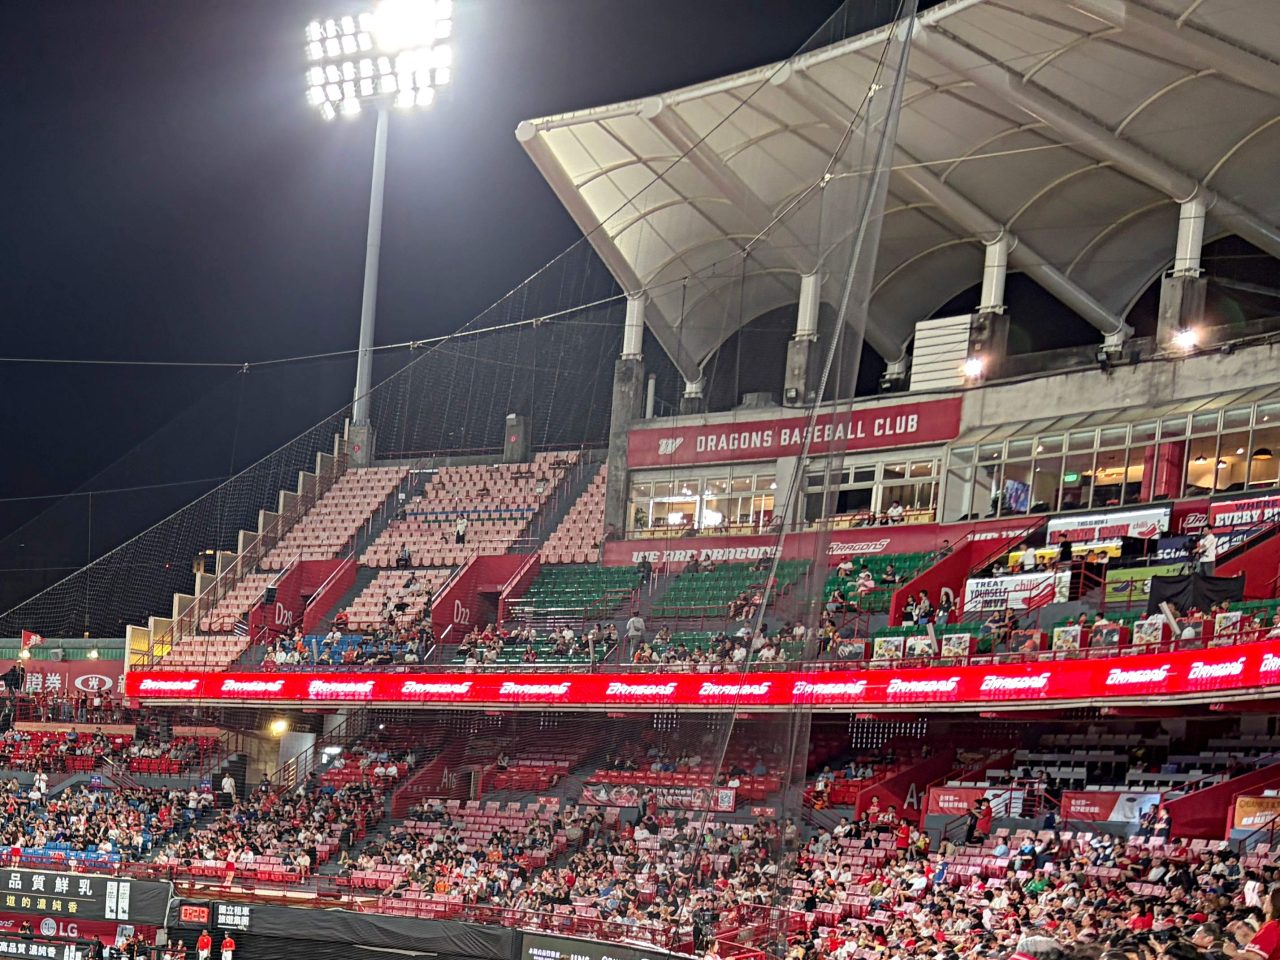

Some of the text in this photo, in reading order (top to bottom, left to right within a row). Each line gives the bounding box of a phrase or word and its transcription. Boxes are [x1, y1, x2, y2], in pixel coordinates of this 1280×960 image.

[697, 430, 772, 453] DRAGONS
[780, 419, 865, 447] BASEBALL
[874, 414, 918, 437] CLUB
[1215, 508, 1261, 526] EVERY
[632, 546, 782, 563] WE ARE DRAGONS
[975, 580, 1004, 588] TREAT
[454, 600, 470, 625] D22
[59, 922, 78, 937] LG
